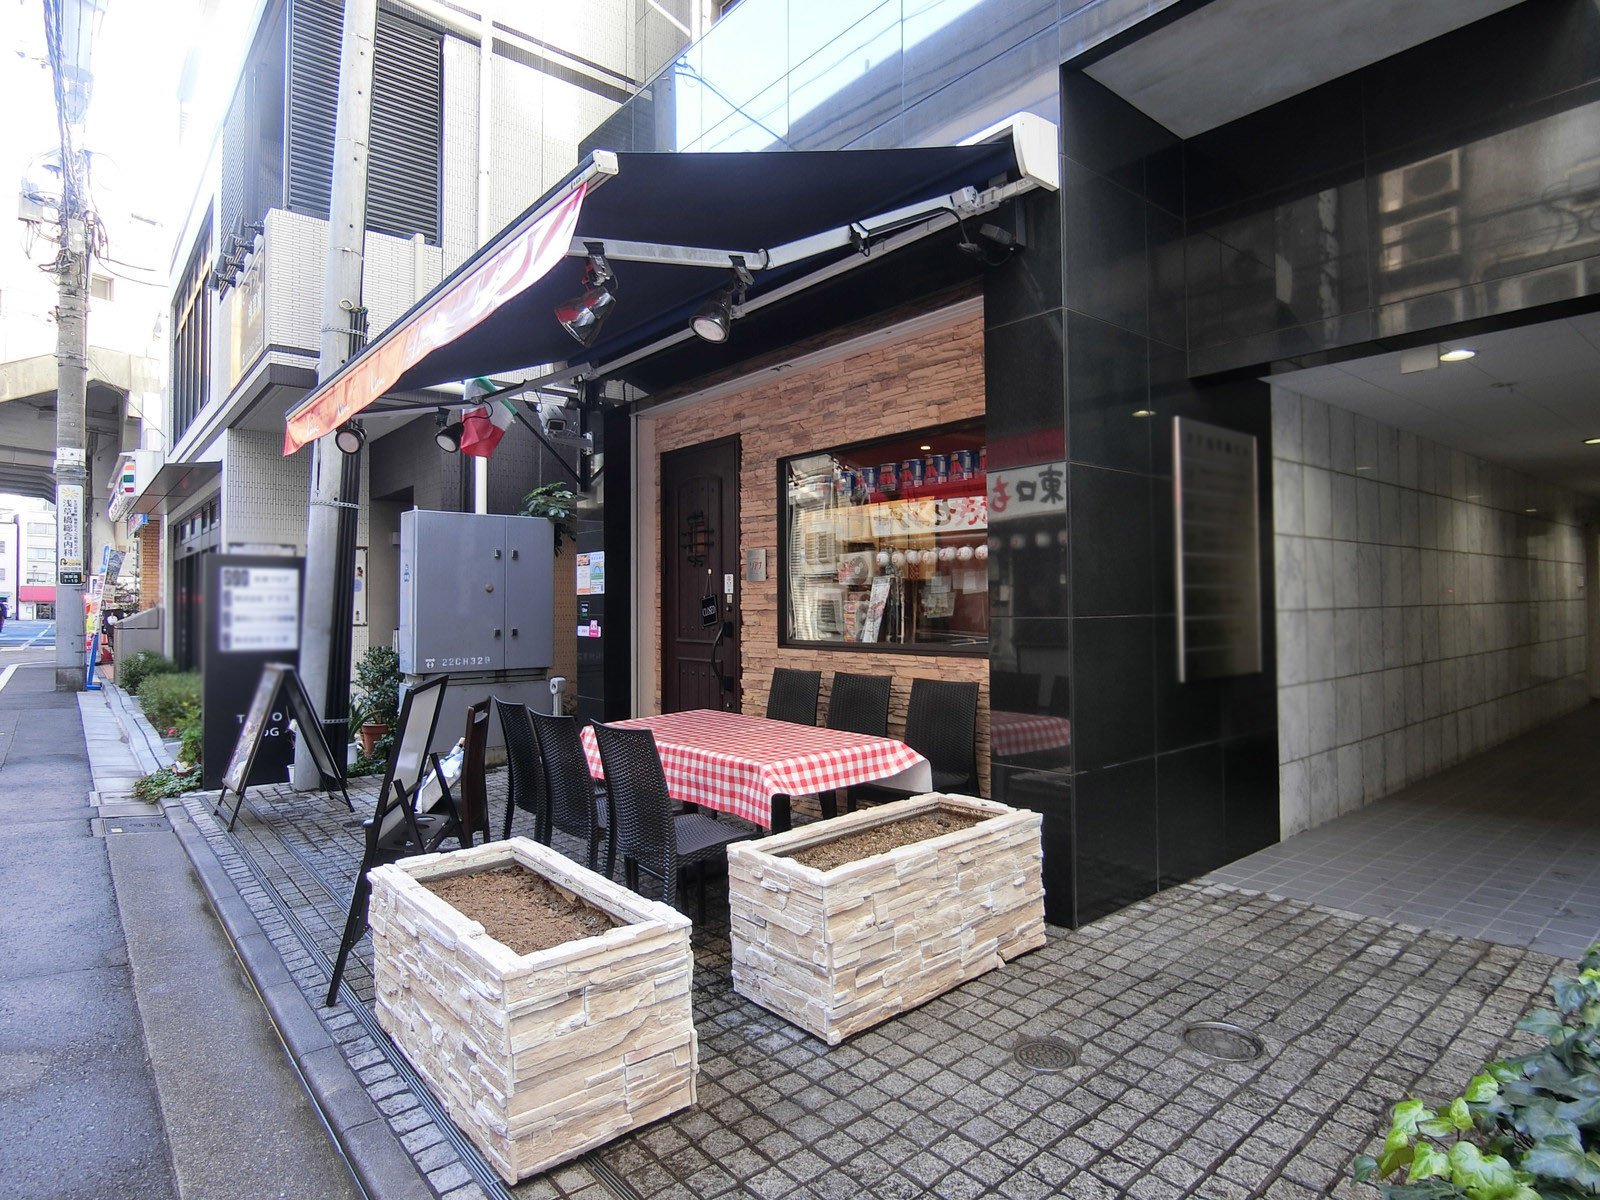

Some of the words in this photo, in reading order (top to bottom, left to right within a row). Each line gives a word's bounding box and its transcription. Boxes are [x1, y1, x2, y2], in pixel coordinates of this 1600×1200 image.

[63, 500, 73, 557] 浅草橋総合内科
